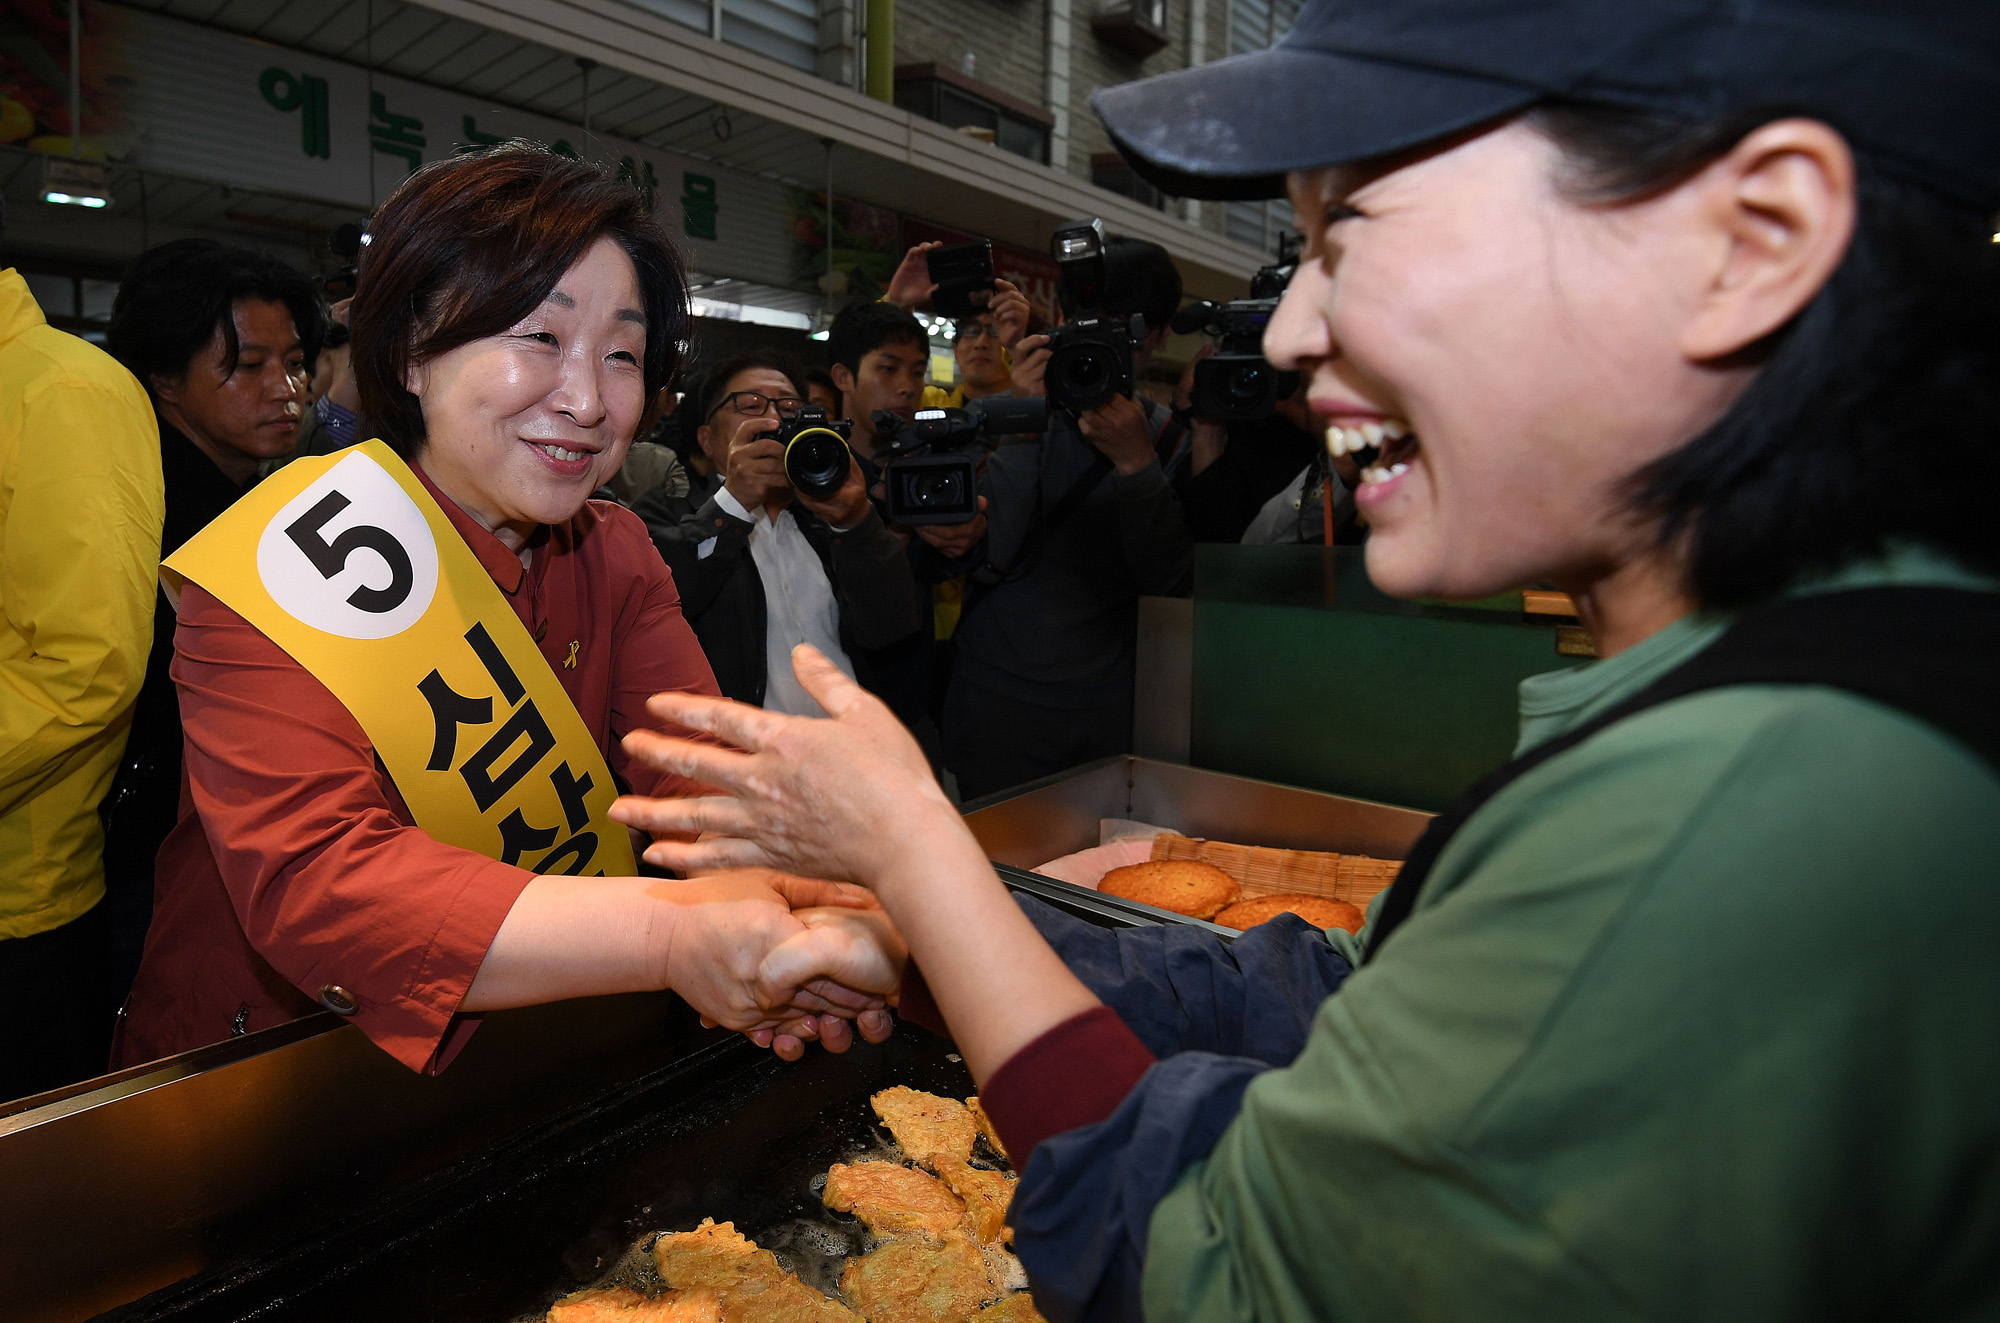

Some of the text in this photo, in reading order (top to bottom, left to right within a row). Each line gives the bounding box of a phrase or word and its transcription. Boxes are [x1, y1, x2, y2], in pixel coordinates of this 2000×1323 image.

[1077, 318, 1099, 326] Canon
[283, 489, 414, 613] 5
[416, 620, 606, 877] 심상
